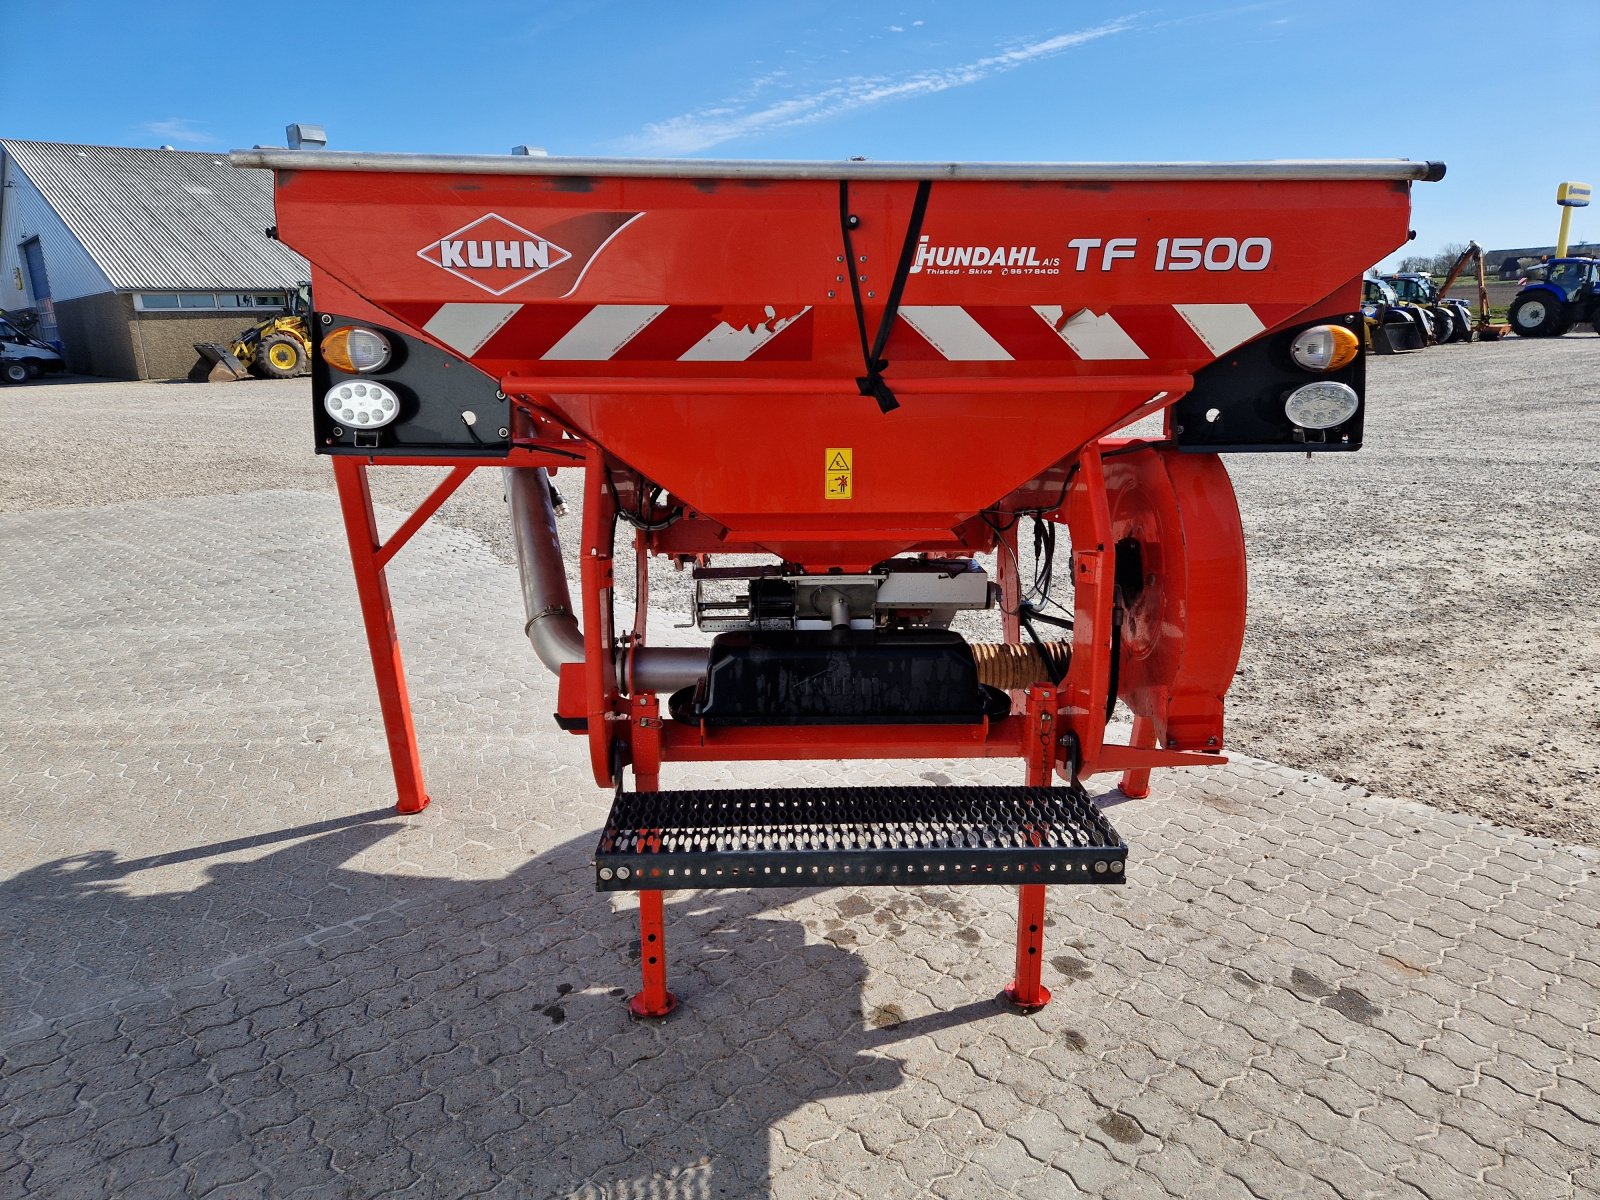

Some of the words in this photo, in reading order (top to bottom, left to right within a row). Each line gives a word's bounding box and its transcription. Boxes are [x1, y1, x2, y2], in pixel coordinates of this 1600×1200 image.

[440, 240, 549, 268] KUHN
[1042, 257, 1060, 267] A/S
[1067, 238, 1138, 272] TF
[1154, 237, 1272, 272] 1500
